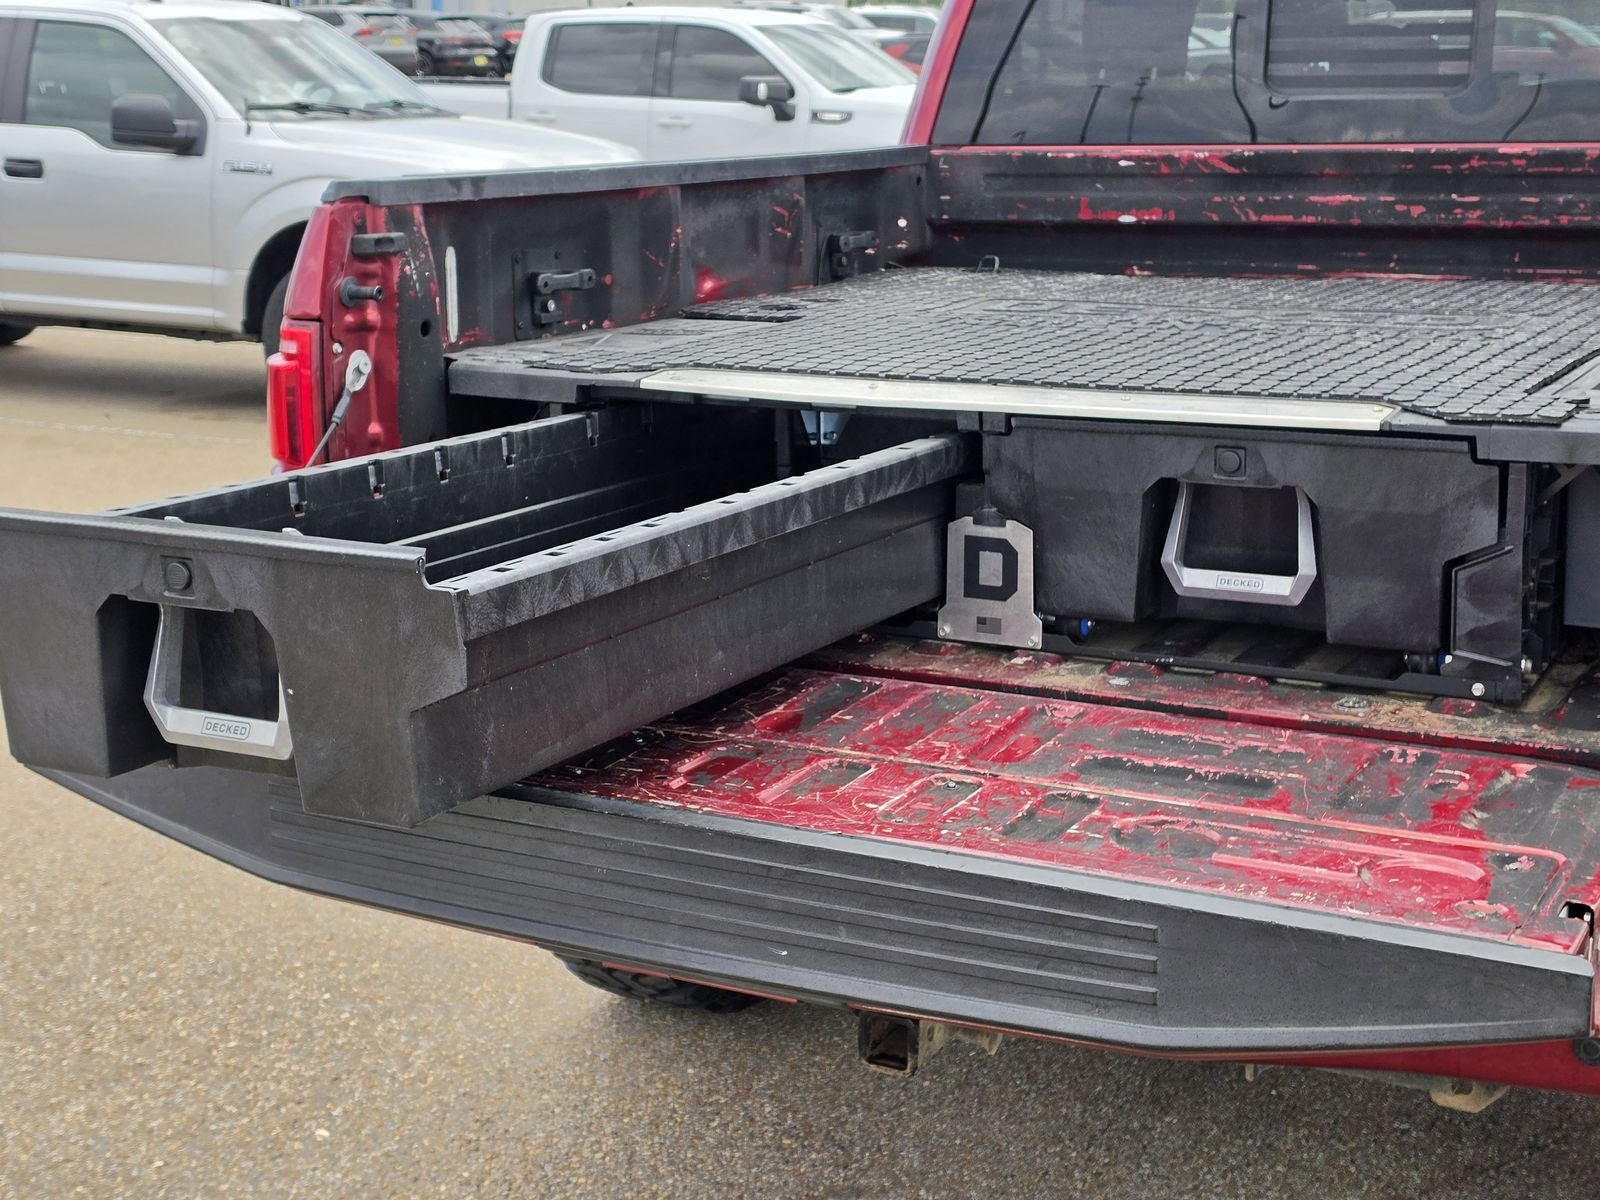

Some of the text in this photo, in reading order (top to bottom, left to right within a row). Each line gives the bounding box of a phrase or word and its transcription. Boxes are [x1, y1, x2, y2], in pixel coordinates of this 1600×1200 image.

[964, 535, 1018, 602] D
[1219, 577, 1261, 589] DECKED
[205, 721, 248, 736] DECKED
